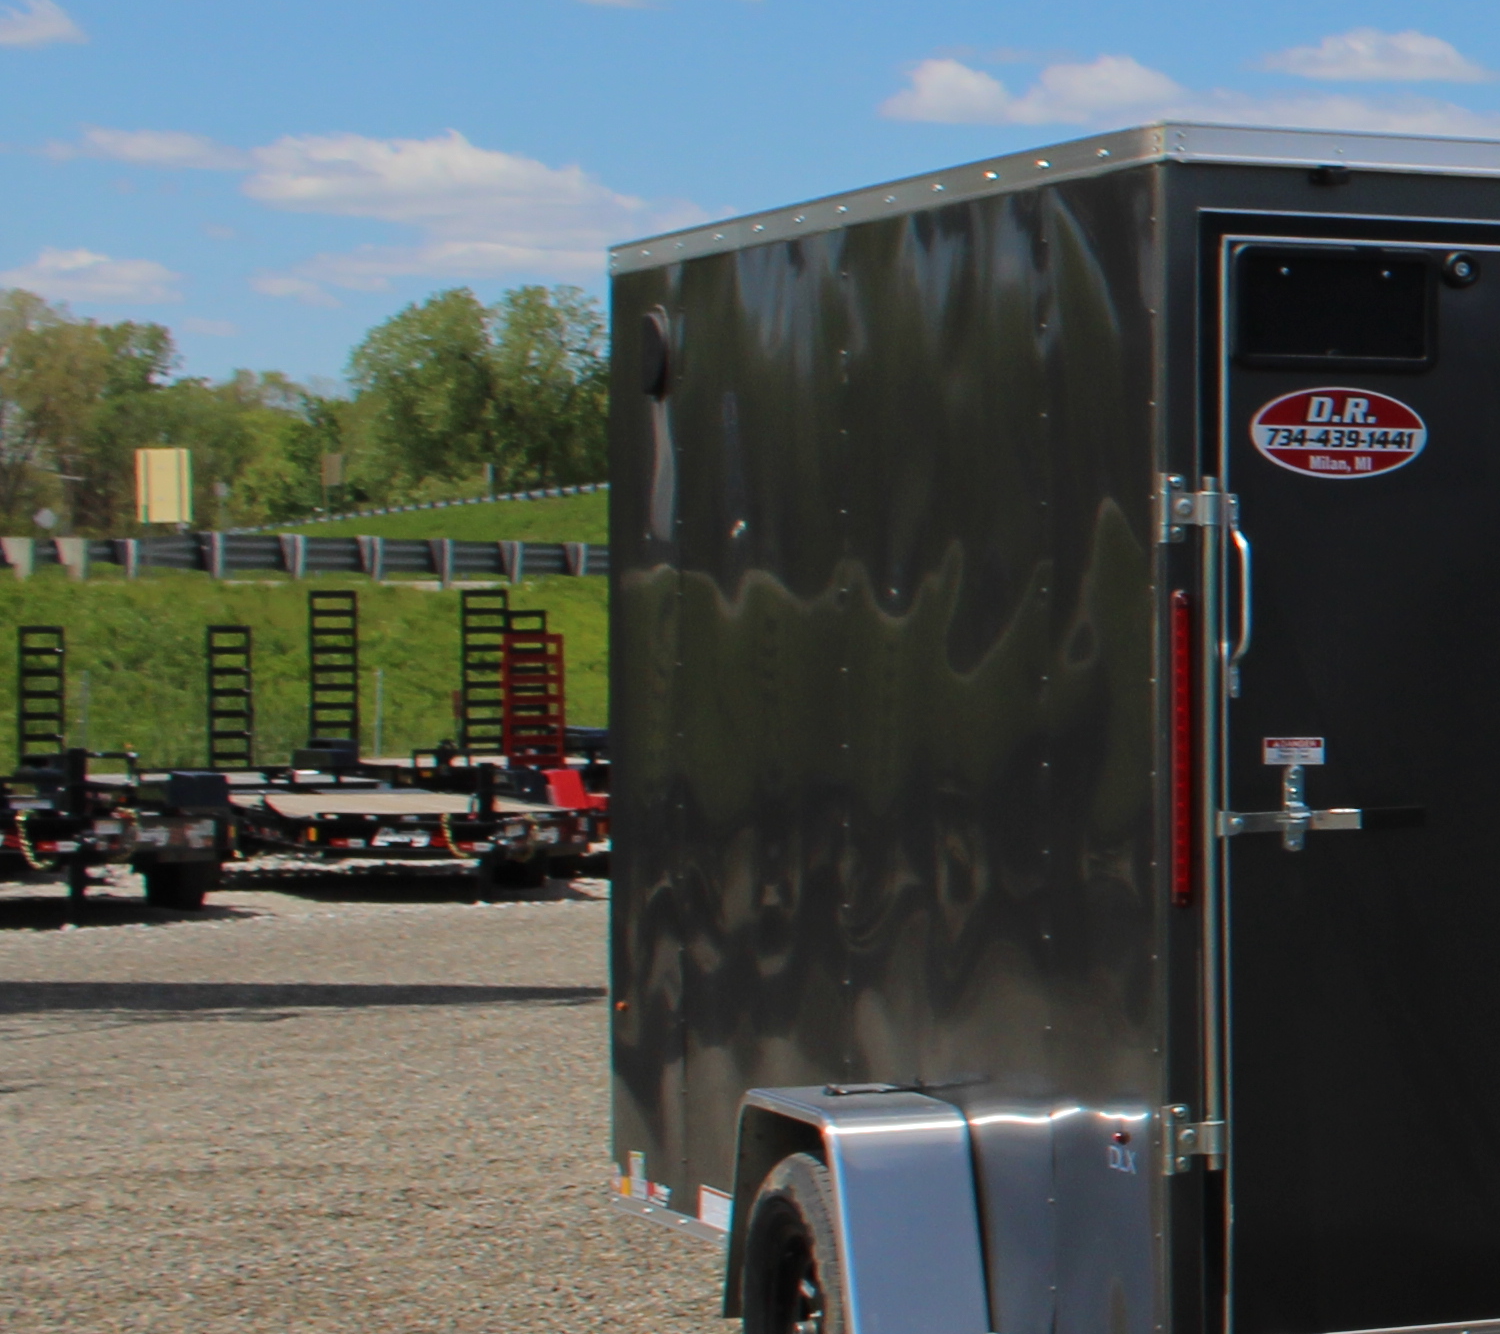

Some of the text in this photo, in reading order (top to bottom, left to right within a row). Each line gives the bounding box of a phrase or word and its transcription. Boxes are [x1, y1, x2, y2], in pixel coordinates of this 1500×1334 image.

[1306, 396, 1377, 424] D.R.
[1267, 428, 1414, 449] 734-439-1441
[1309, 455, 1372, 471] Milan, MI
